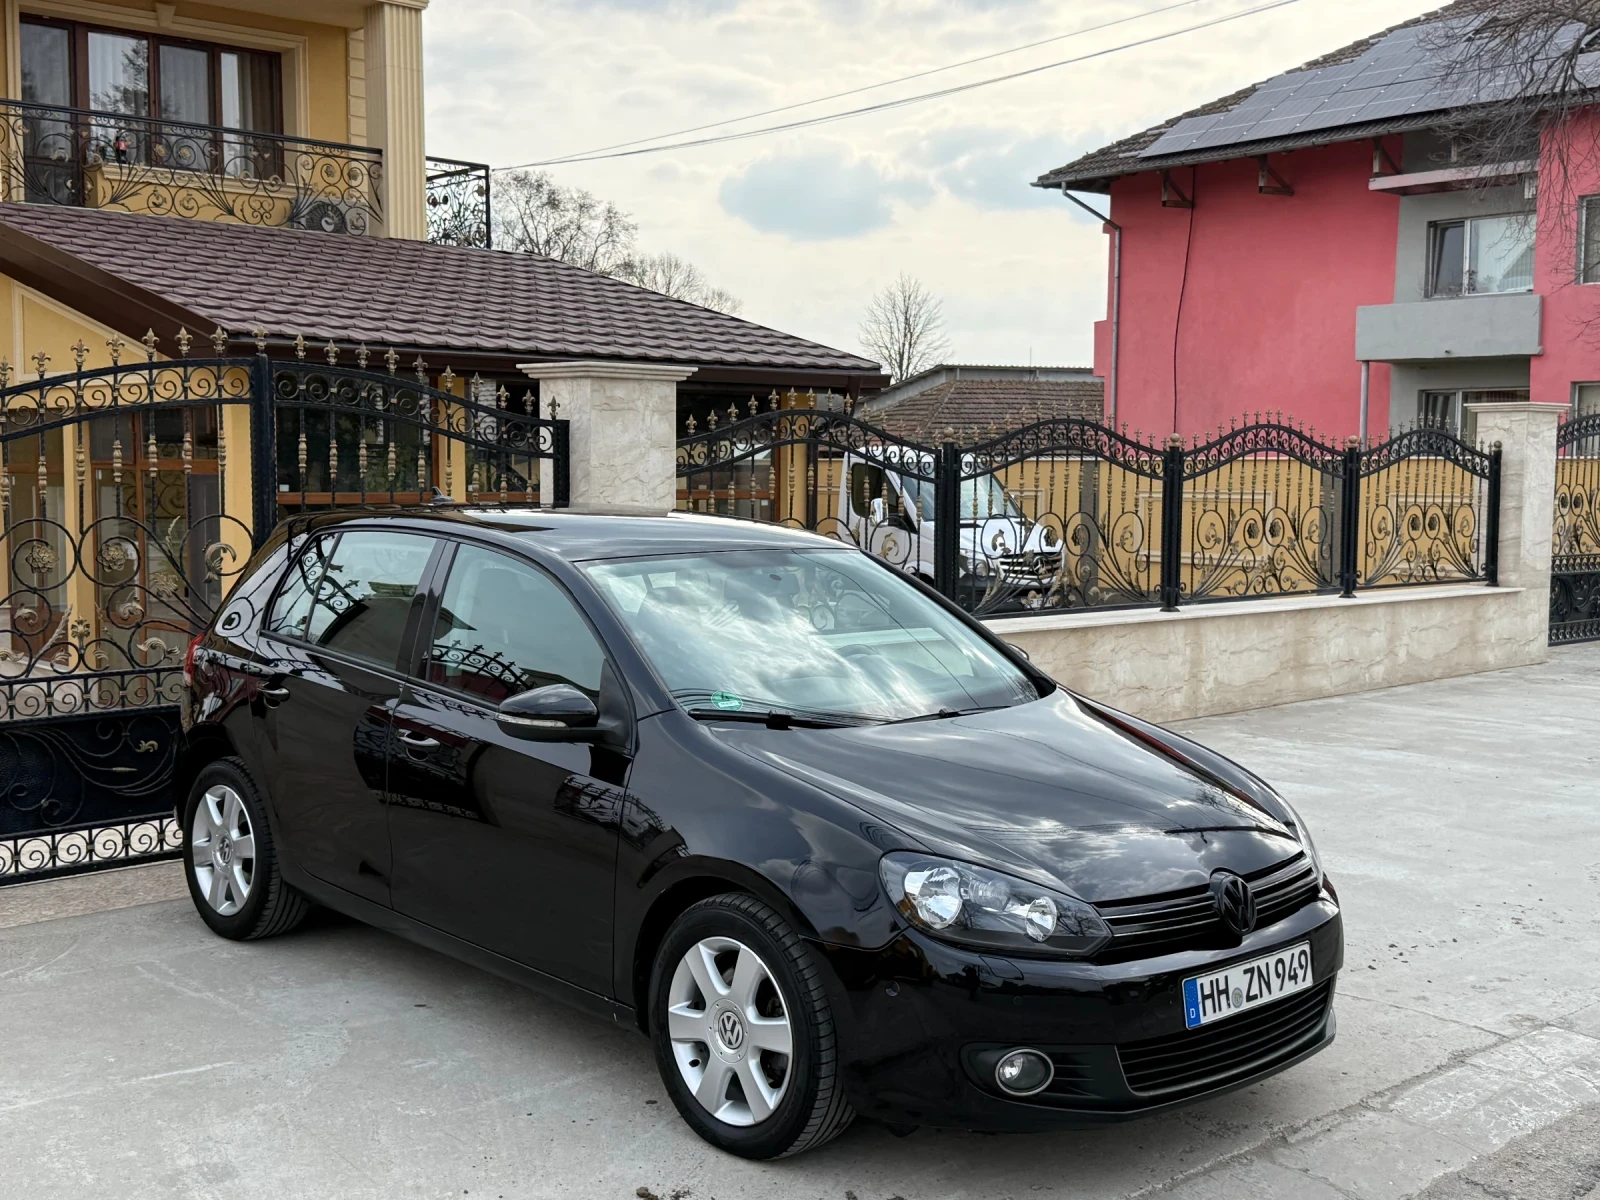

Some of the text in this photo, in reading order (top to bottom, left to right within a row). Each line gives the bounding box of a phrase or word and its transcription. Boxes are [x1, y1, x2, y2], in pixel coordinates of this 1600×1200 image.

[1200, 975, 1231, 1017] HH
[1243, 961, 1272, 1003] ZN
[1274, 949, 1309, 992] 949
[719, 1011, 743, 1049] VW
[1189, 1007, 1196, 1019] D
